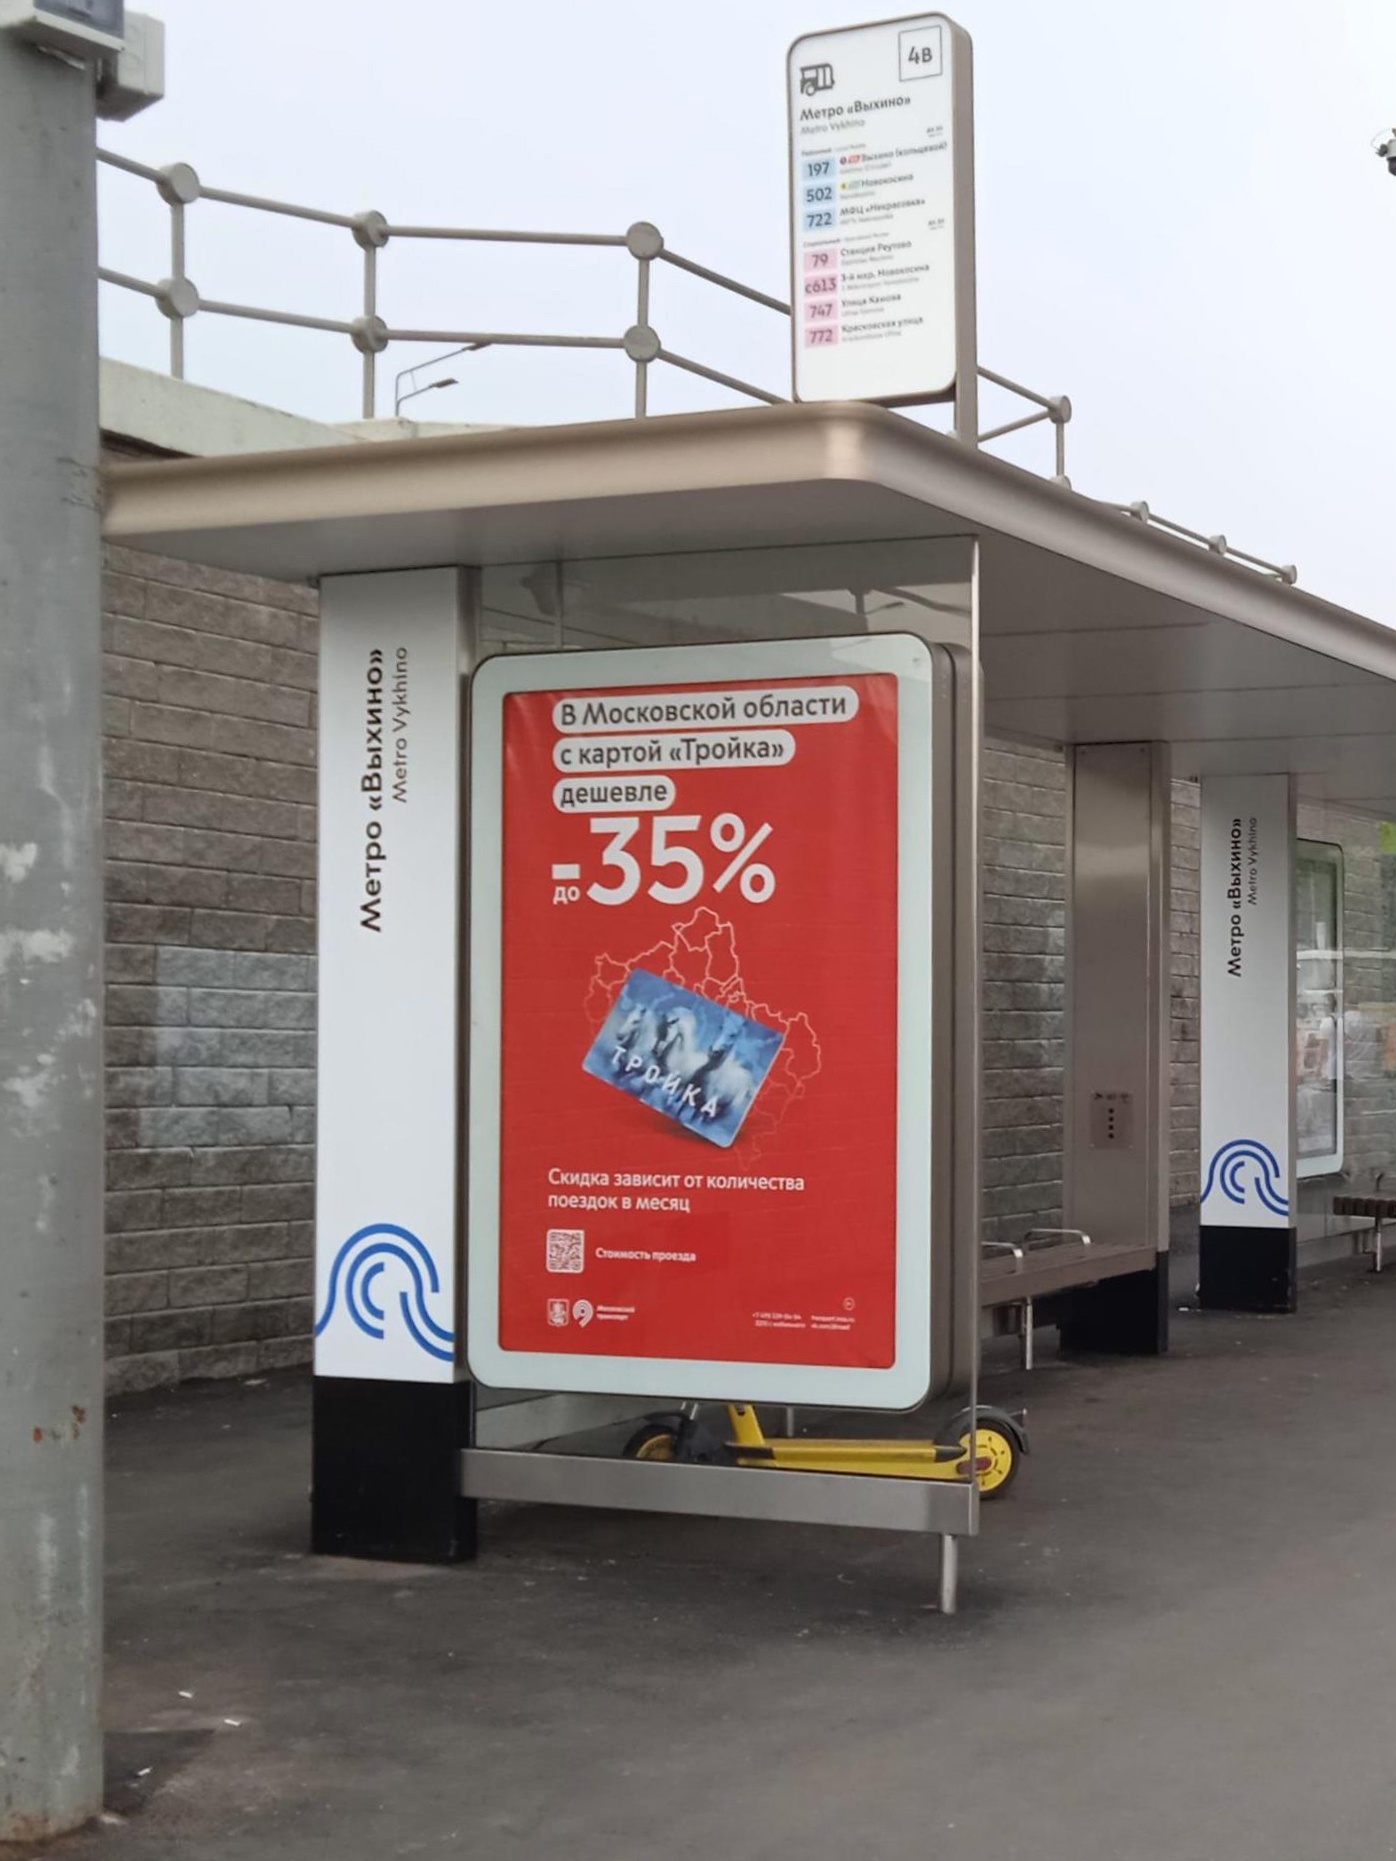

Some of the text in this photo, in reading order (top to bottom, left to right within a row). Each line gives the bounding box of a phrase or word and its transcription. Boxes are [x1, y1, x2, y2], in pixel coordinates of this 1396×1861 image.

[908, 46, 933, 65] 4В
[799, 96, 911, 121] Метро «Выхино»
[800, 123, 828, 135] Metro
[807, 161, 830, 177] 197
[806, 187, 832, 202] 502
[806, 213, 832, 228] 722
[811, 253, 829, 268] 79
[804, 277, 837, 294] с613
[809, 304, 833, 319] 747
[810, 329, 833, 344] 772
[560, 694, 847, 726] В Московской области
[392, 646, 411, 804] Metro Vykhino
[560, 736, 784, 768] с картой «Тройка»
[360, 648, 387, 933] Метро «Выхино»
[560, 782, 668, 808] дешевле
[1247, 816, 1259, 906] Metro Vykhino
[552, 886, 581, 905] до
[1227, 817, 1246, 978] Метро «Выхино»
[611, 1045, 719, 1118] ТРОЙКА
[548, 1167, 805, 1191] Скидка зависит от количества
[547, 1193, 691, 1214] поездок в месяц
[595, 1247, 697, 1263] Стоимость проезда
